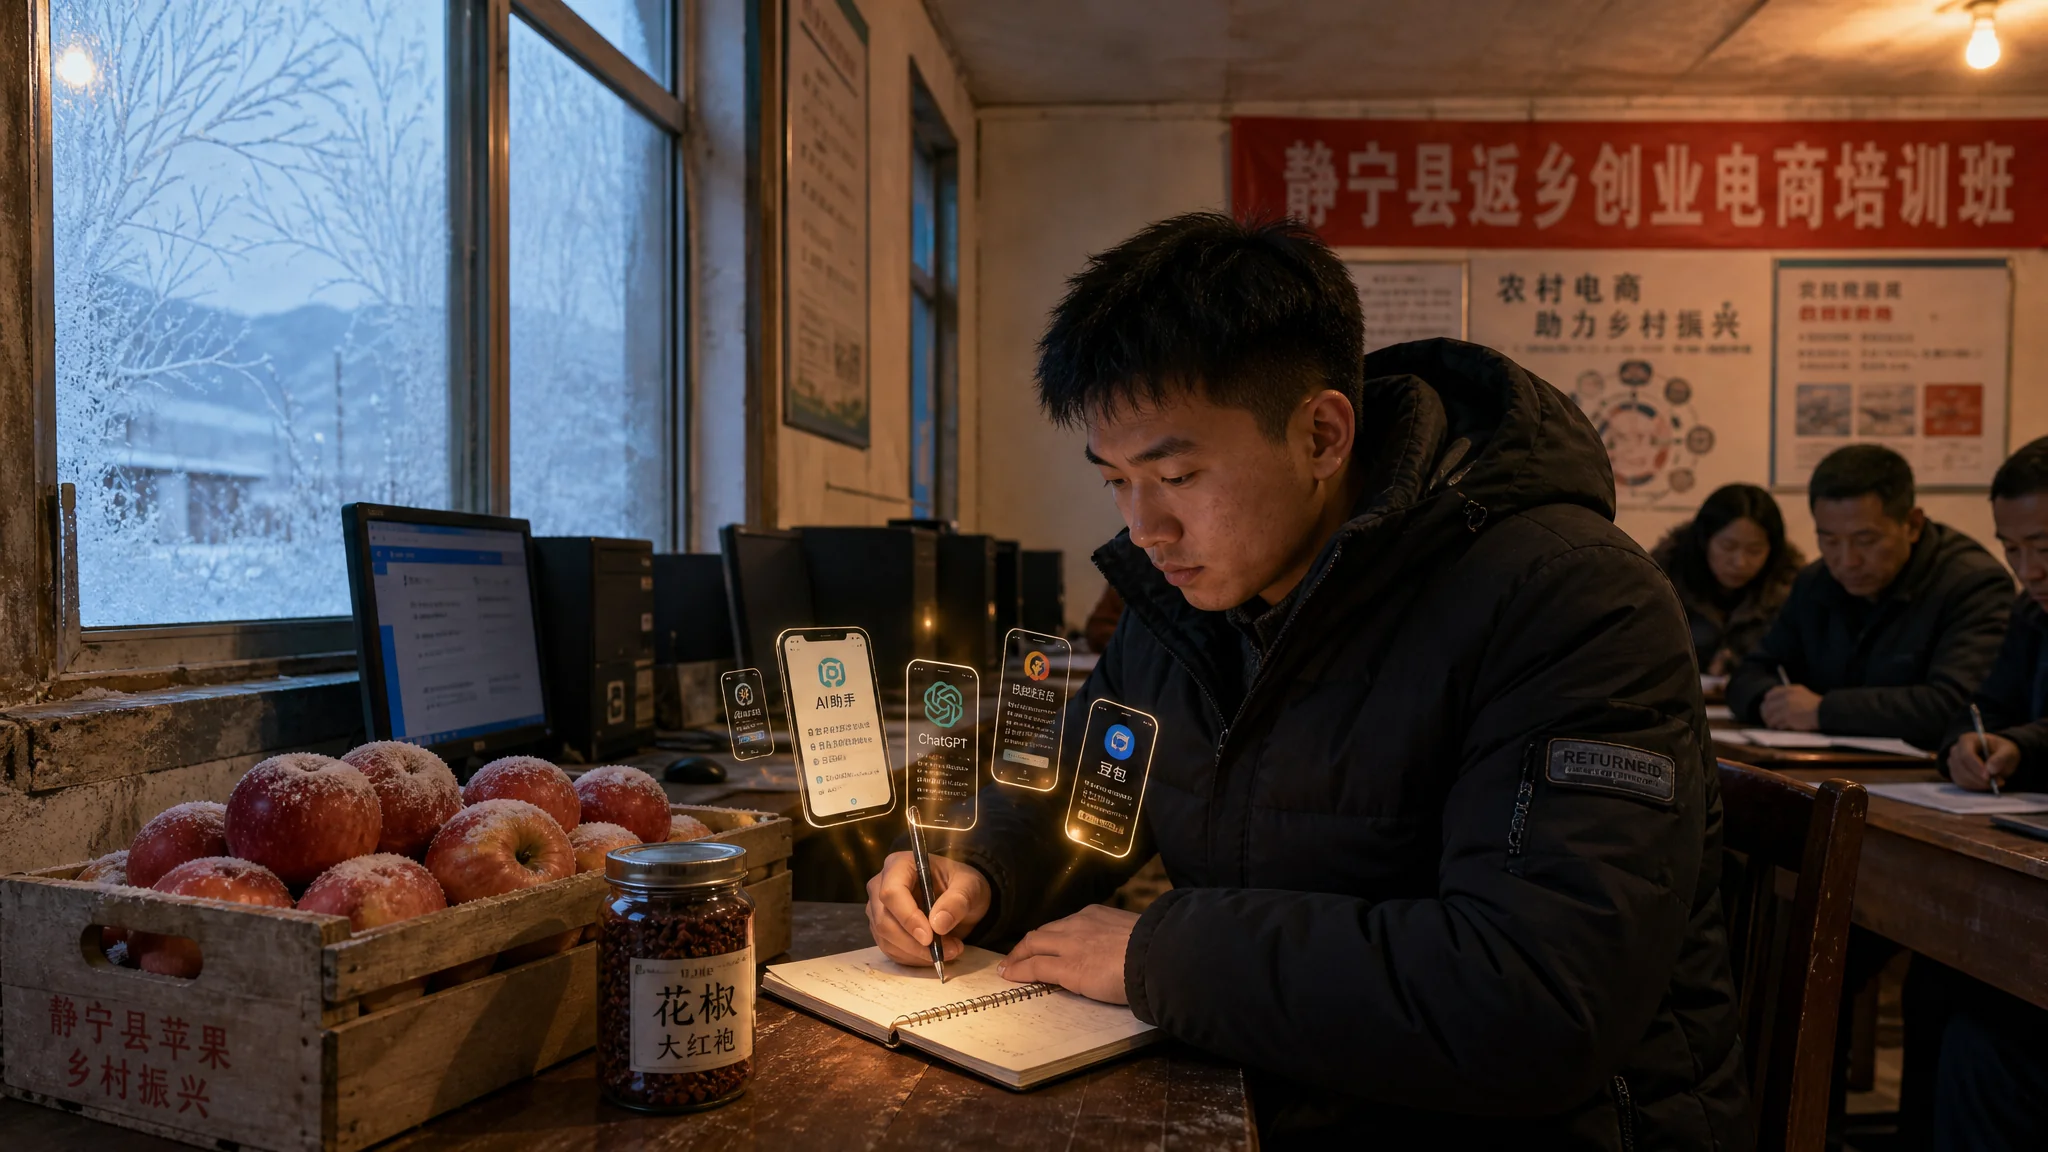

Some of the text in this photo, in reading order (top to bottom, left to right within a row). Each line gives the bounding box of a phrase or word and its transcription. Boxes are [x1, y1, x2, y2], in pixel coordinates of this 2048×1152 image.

[1283, 140, 2015, 229] 静宁县返乡创业电商培训班
[1497, 272, 1641, 303] 农村电商
[1534, 302, 1740, 339] 助力乡村振兴
[815, 693, 856, 710] AI助手
[918, 733, 968, 749] ChatGPT
[1097, 761, 1127, 783] 豆包
[652, 982, 738, 1027] 花椒
[48, 995, 231, 1070] 静宁县苹果
[656, 1028, 736, 1060] 大红袍
[67, 1048, 211, 1119] 乡村振兴
